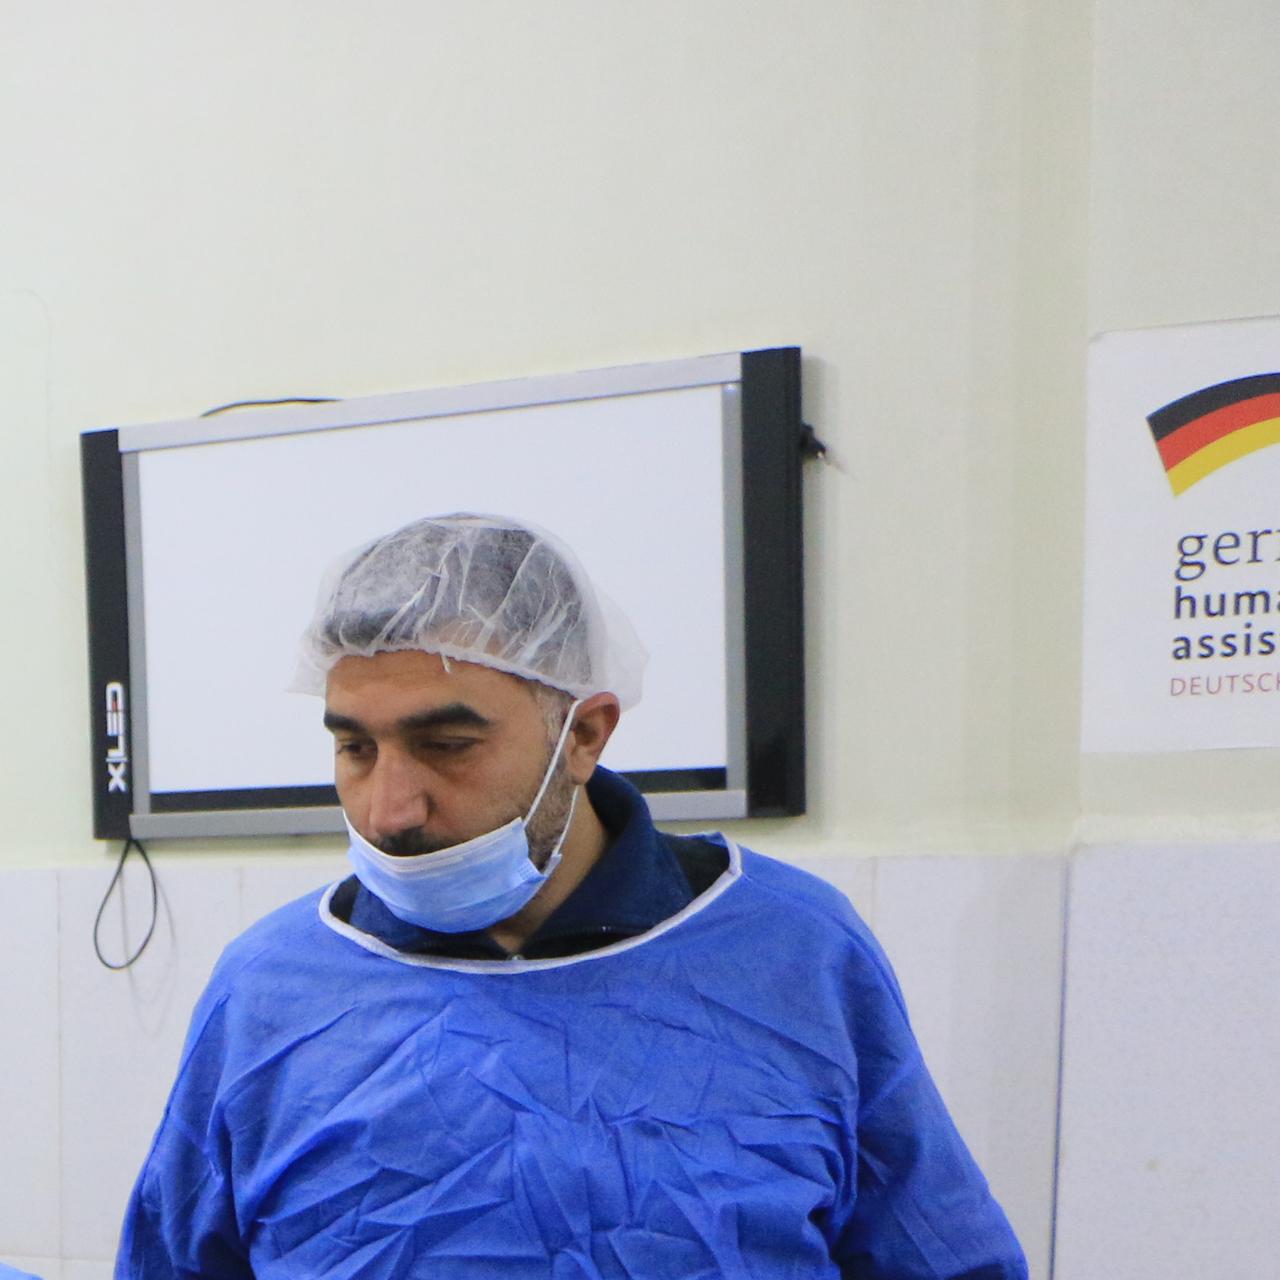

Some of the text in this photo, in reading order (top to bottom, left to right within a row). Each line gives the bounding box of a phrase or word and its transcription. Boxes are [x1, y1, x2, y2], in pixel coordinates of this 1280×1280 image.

[1175, 528, 1280, 581] ger
[1174, 585, 1280, 619] hum
[1172, 622, 1280, 660] assis
[1170, 673, 1280, 696] DEUTSC
